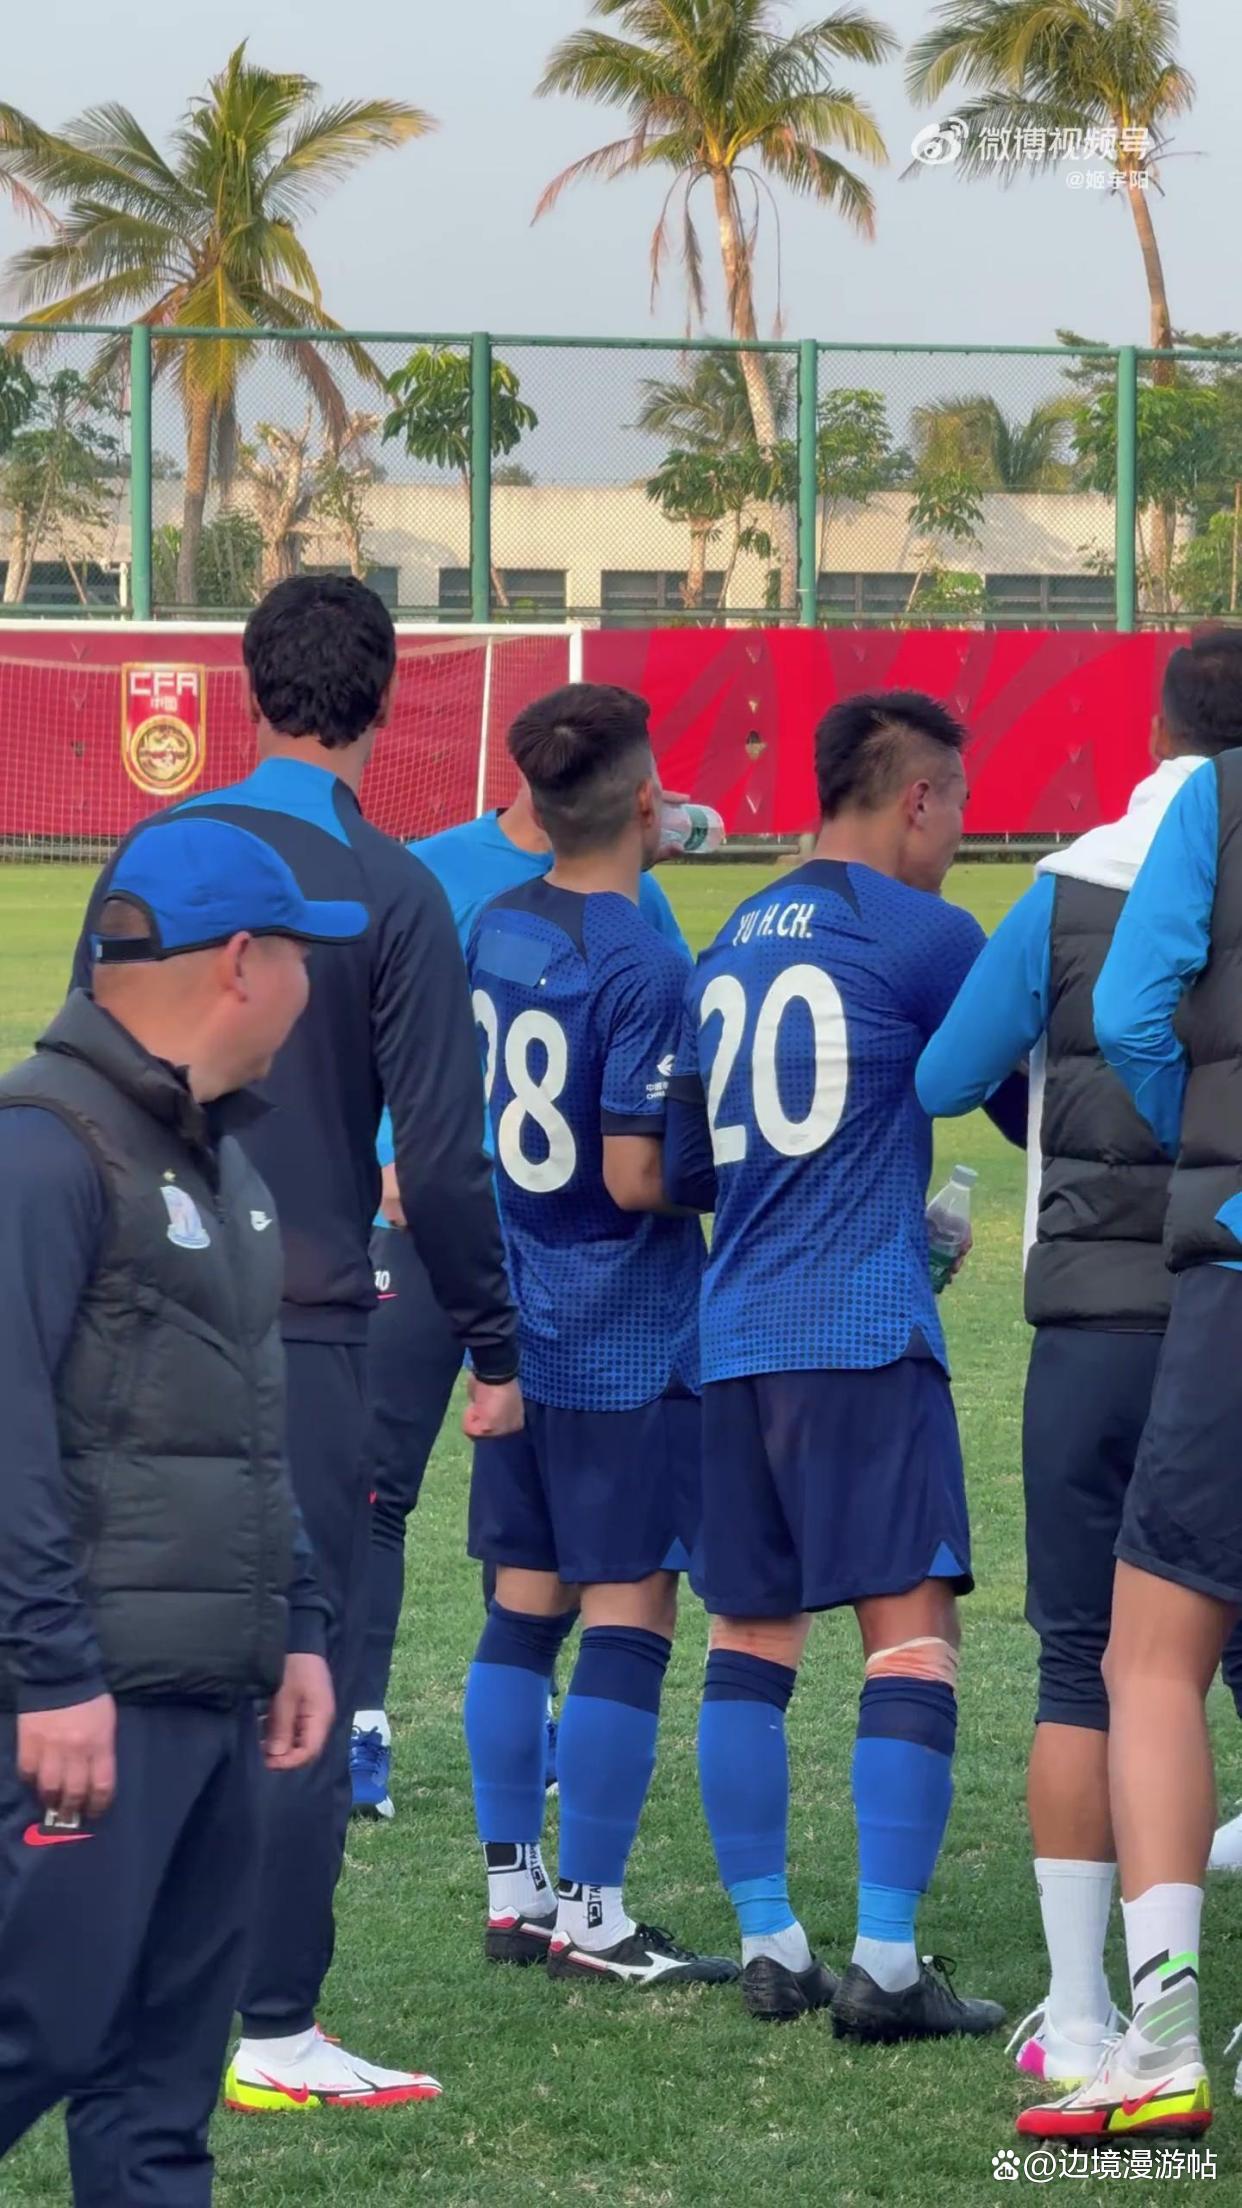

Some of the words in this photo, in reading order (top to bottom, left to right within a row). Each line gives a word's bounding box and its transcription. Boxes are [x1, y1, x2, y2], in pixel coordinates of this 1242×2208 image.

[130, 671, 198, 696] CFA
[732, 909, 761, 947] YU
[756, 903, 815, 939] H.CH.
[700, 963, 849, 1167] 20
